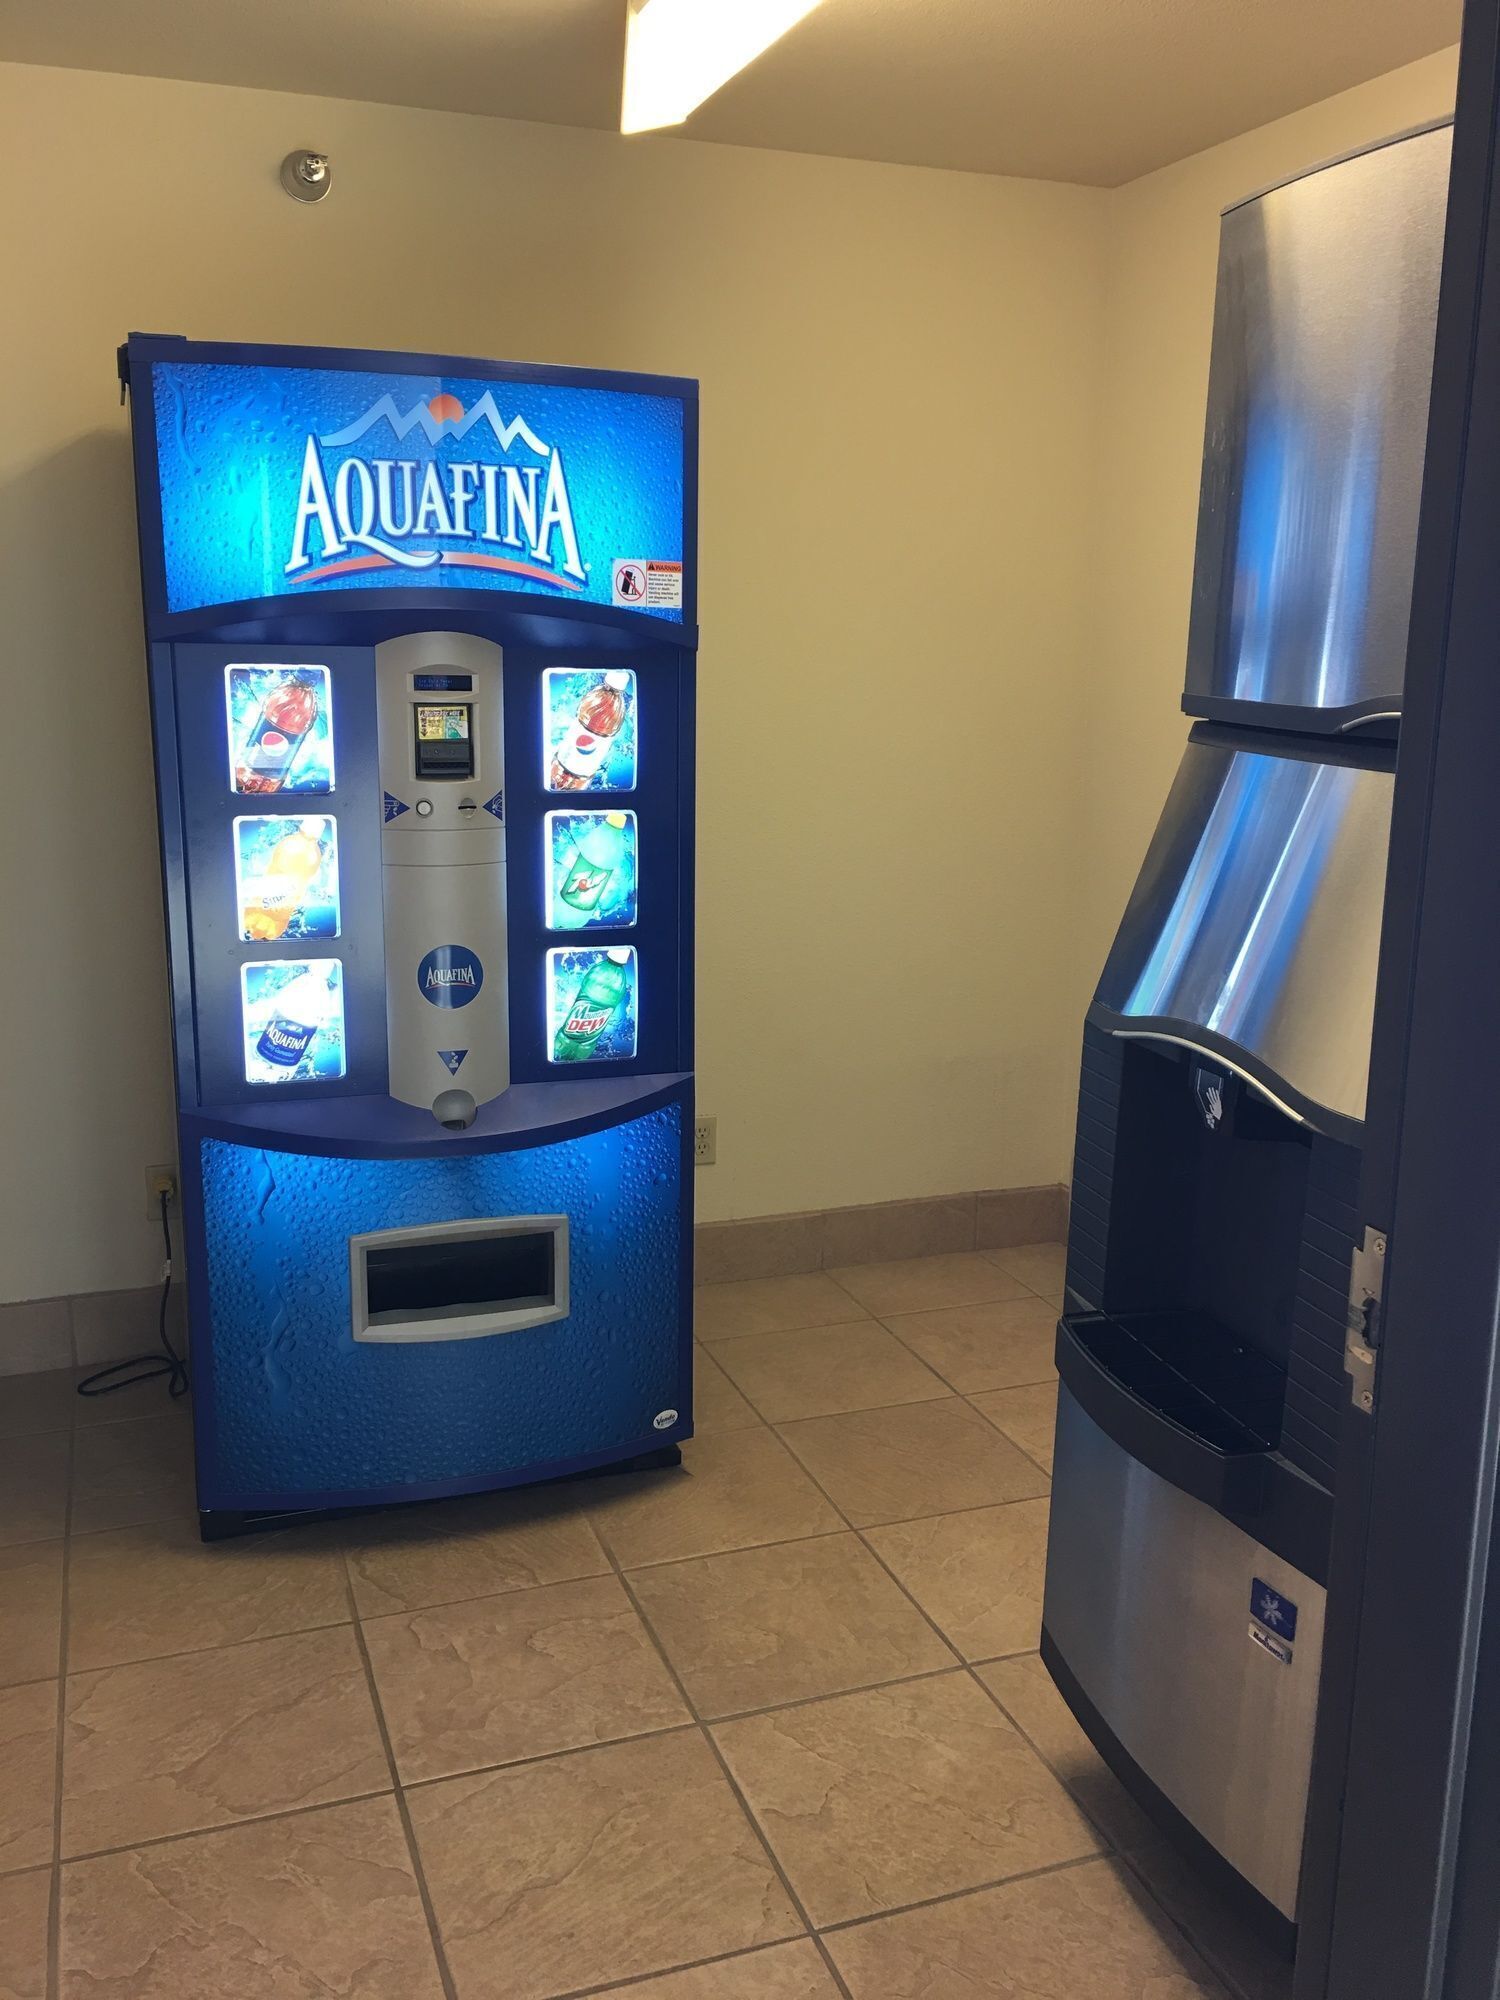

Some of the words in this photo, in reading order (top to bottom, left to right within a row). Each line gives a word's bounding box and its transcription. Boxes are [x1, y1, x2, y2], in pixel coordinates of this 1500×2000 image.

[284, 432, 587, 581] AQUAFINA
[655, 564, 682, 572] WARNING
[425, 964, 476, 988] AQUAFINA
[266, 1020, 308, 1050] AQUAFINA
